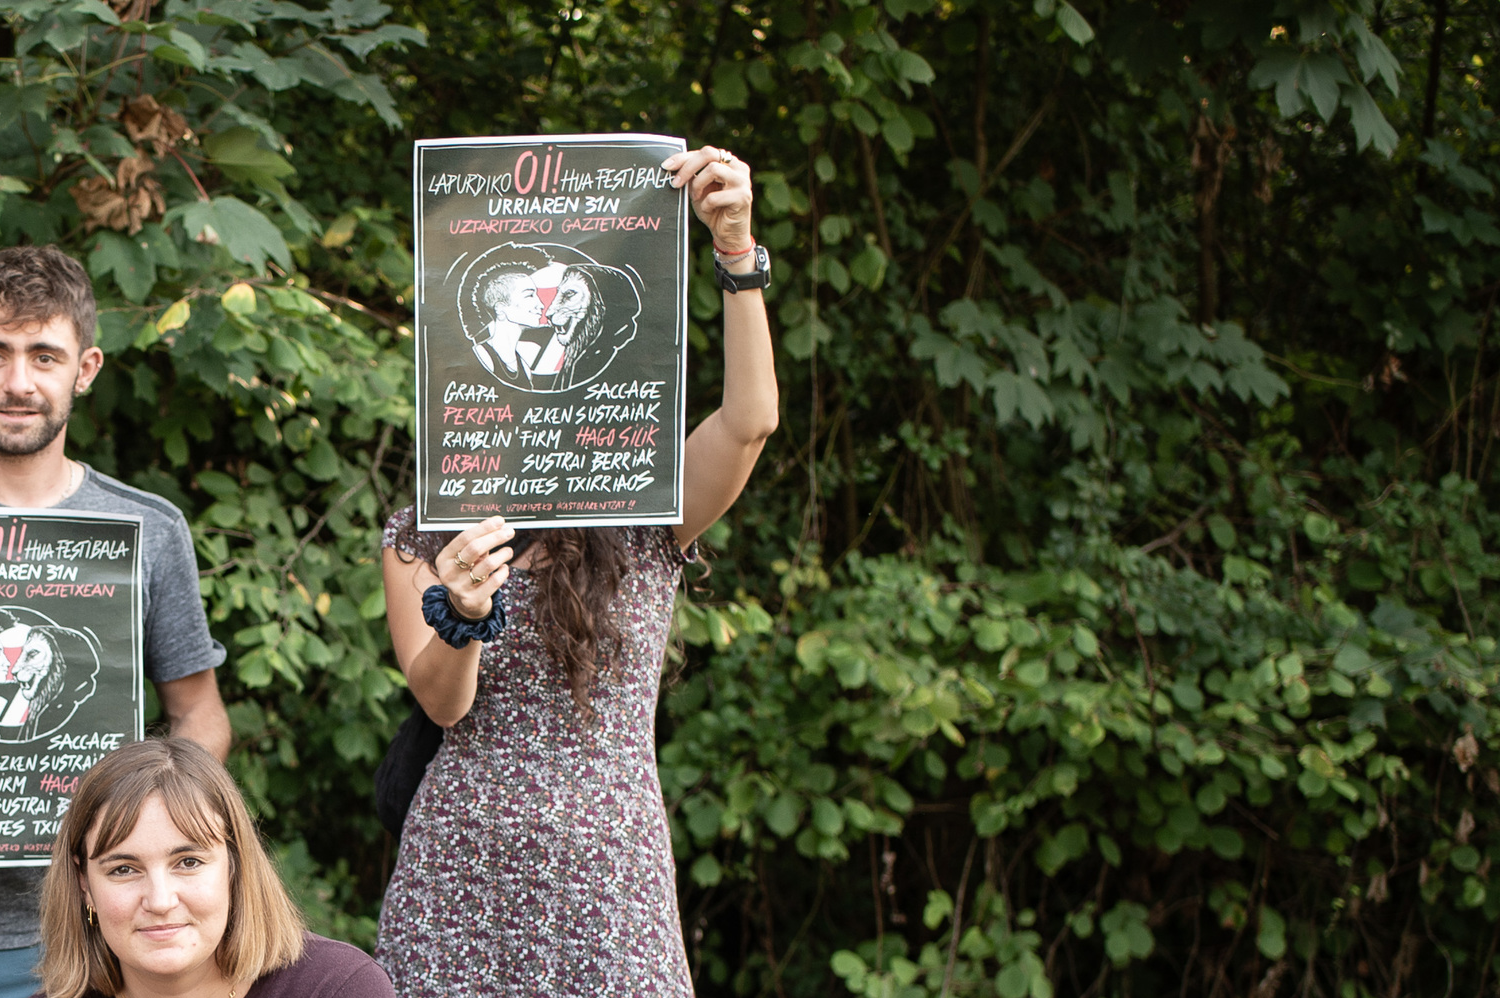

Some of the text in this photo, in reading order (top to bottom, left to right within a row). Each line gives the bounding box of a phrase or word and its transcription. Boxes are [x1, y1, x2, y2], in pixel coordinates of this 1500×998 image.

[428, 173, 511, 197] LAPURDIKO
[489, 196, 620, 216] URRIAREN 31N
[450, 216, 661, 235] UZTARITZEKO GAZTETXEAN
[443, 380, 666, 403] GRAPA SACCAGE
[443, 404, 514, 426] PERLATA
[522, 405, 574, 425] AZKEN
[575, 425, 616, 447] HAGO
[439, 477, 466, 496] LOS
[47, 564, 78, 581] 31N
[25, 583, 115, 598] GAZTETXEAN
[47, 732, 125, 750] SACCAGE
[39, 753, 105, 772] SUSTRAI
[40, 774, 79, 793] HAGO
